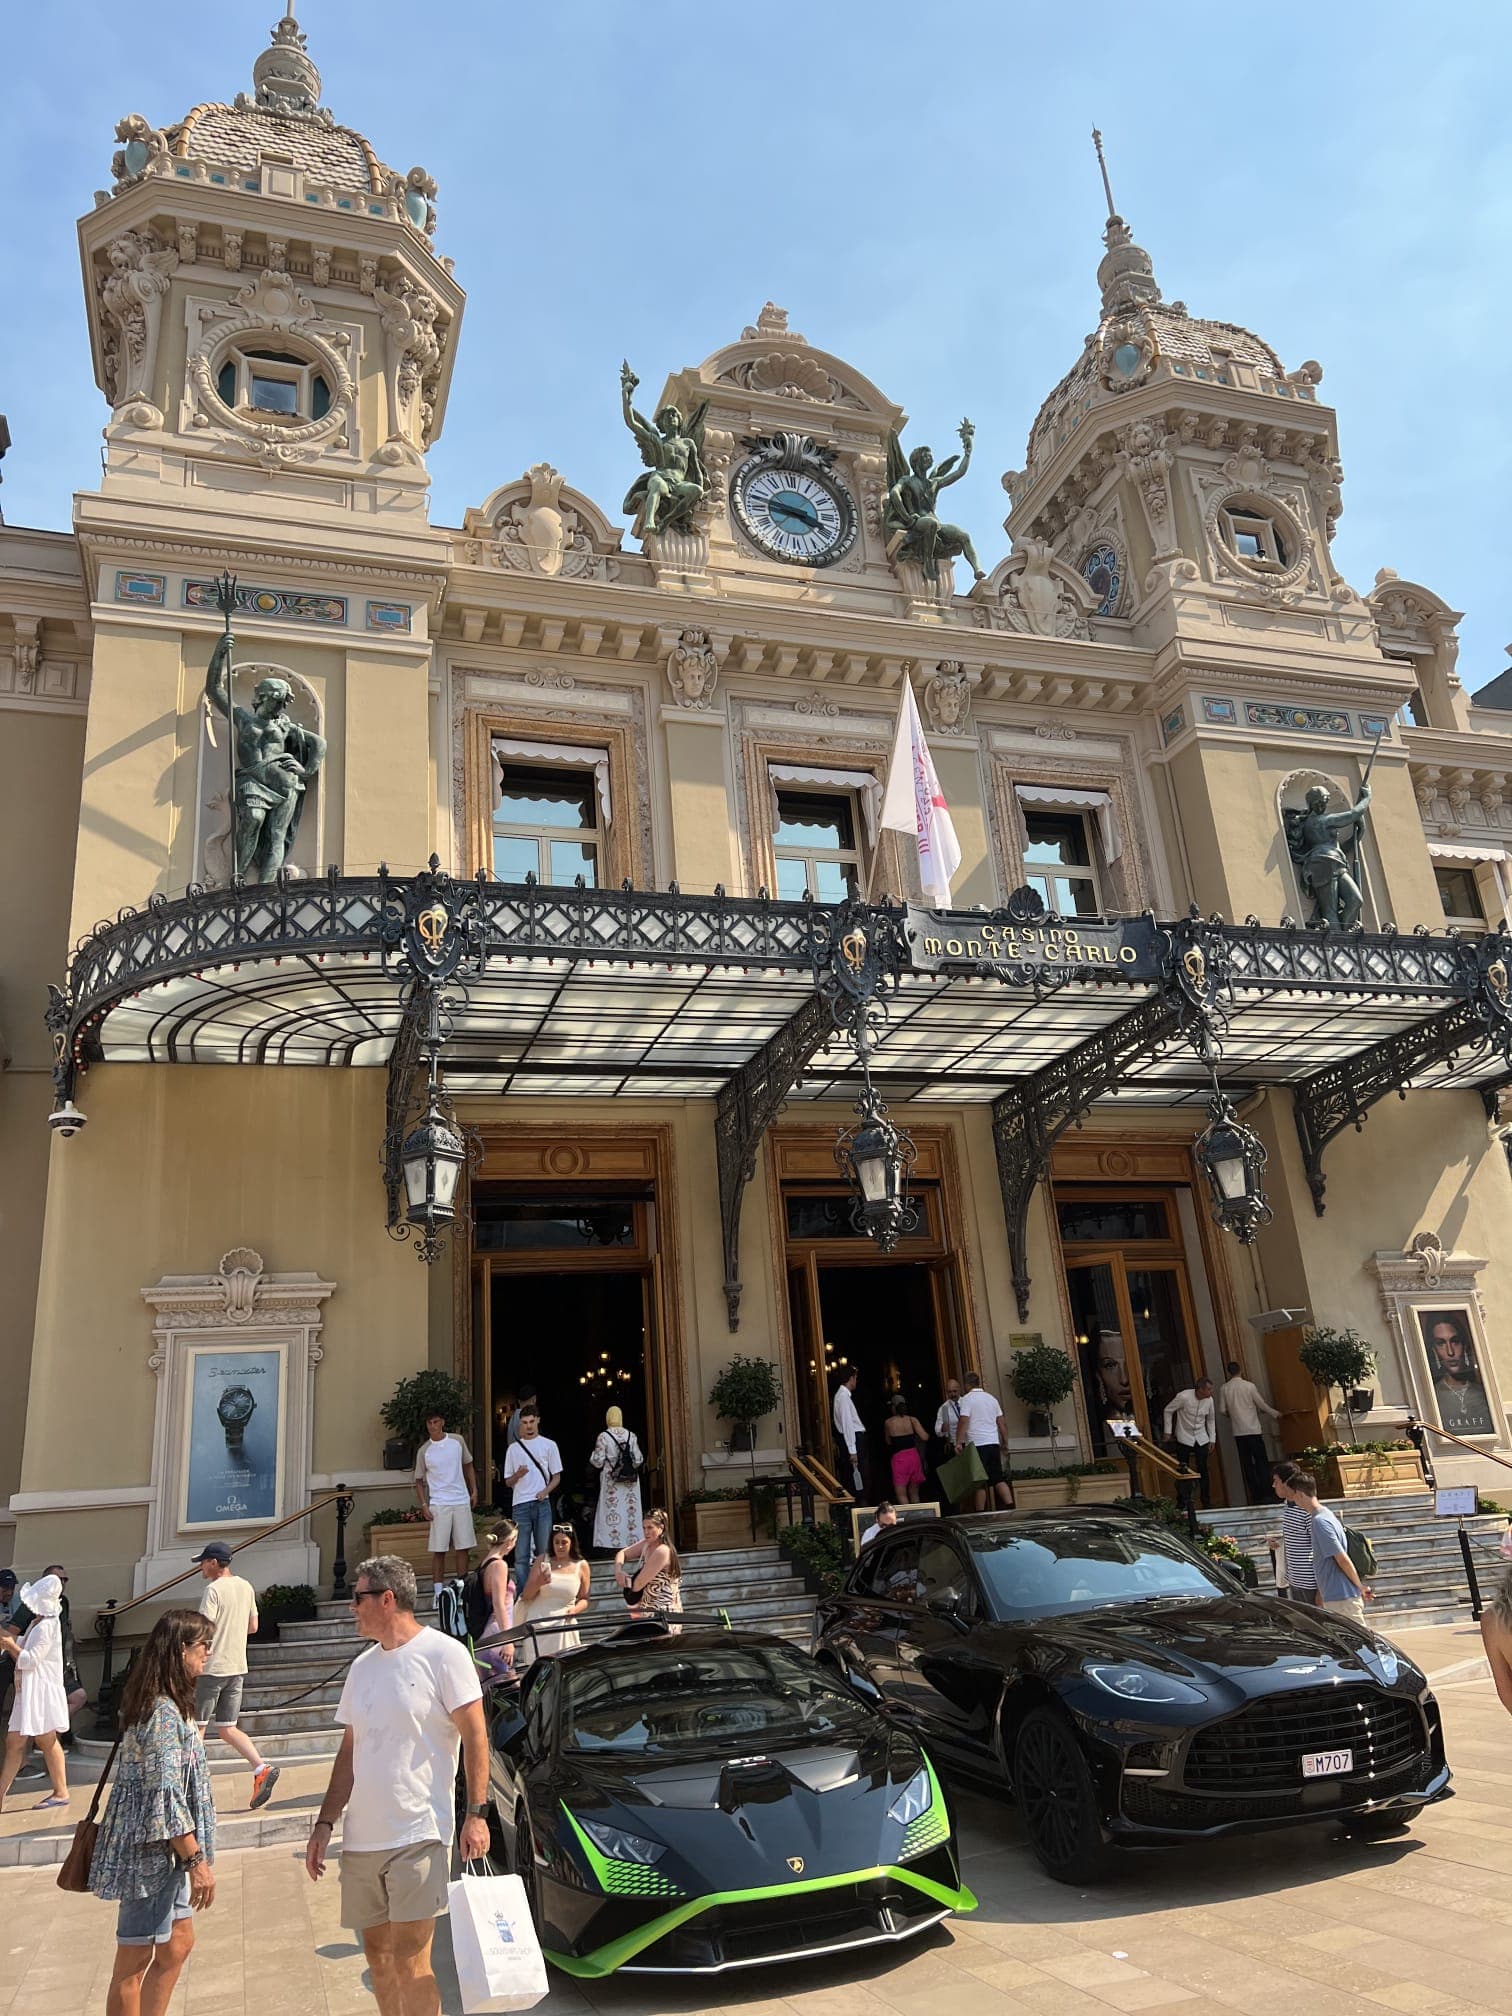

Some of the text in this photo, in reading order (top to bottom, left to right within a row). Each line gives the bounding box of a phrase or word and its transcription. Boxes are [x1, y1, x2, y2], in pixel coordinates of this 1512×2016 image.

[981, 925, 1078, 944] CASINO
[1449, 1417, 1486, 1427] GRAFF
[216, 1504, 247, 1512] OMEGA
[1315, 1753, 1349, 1773] M707
